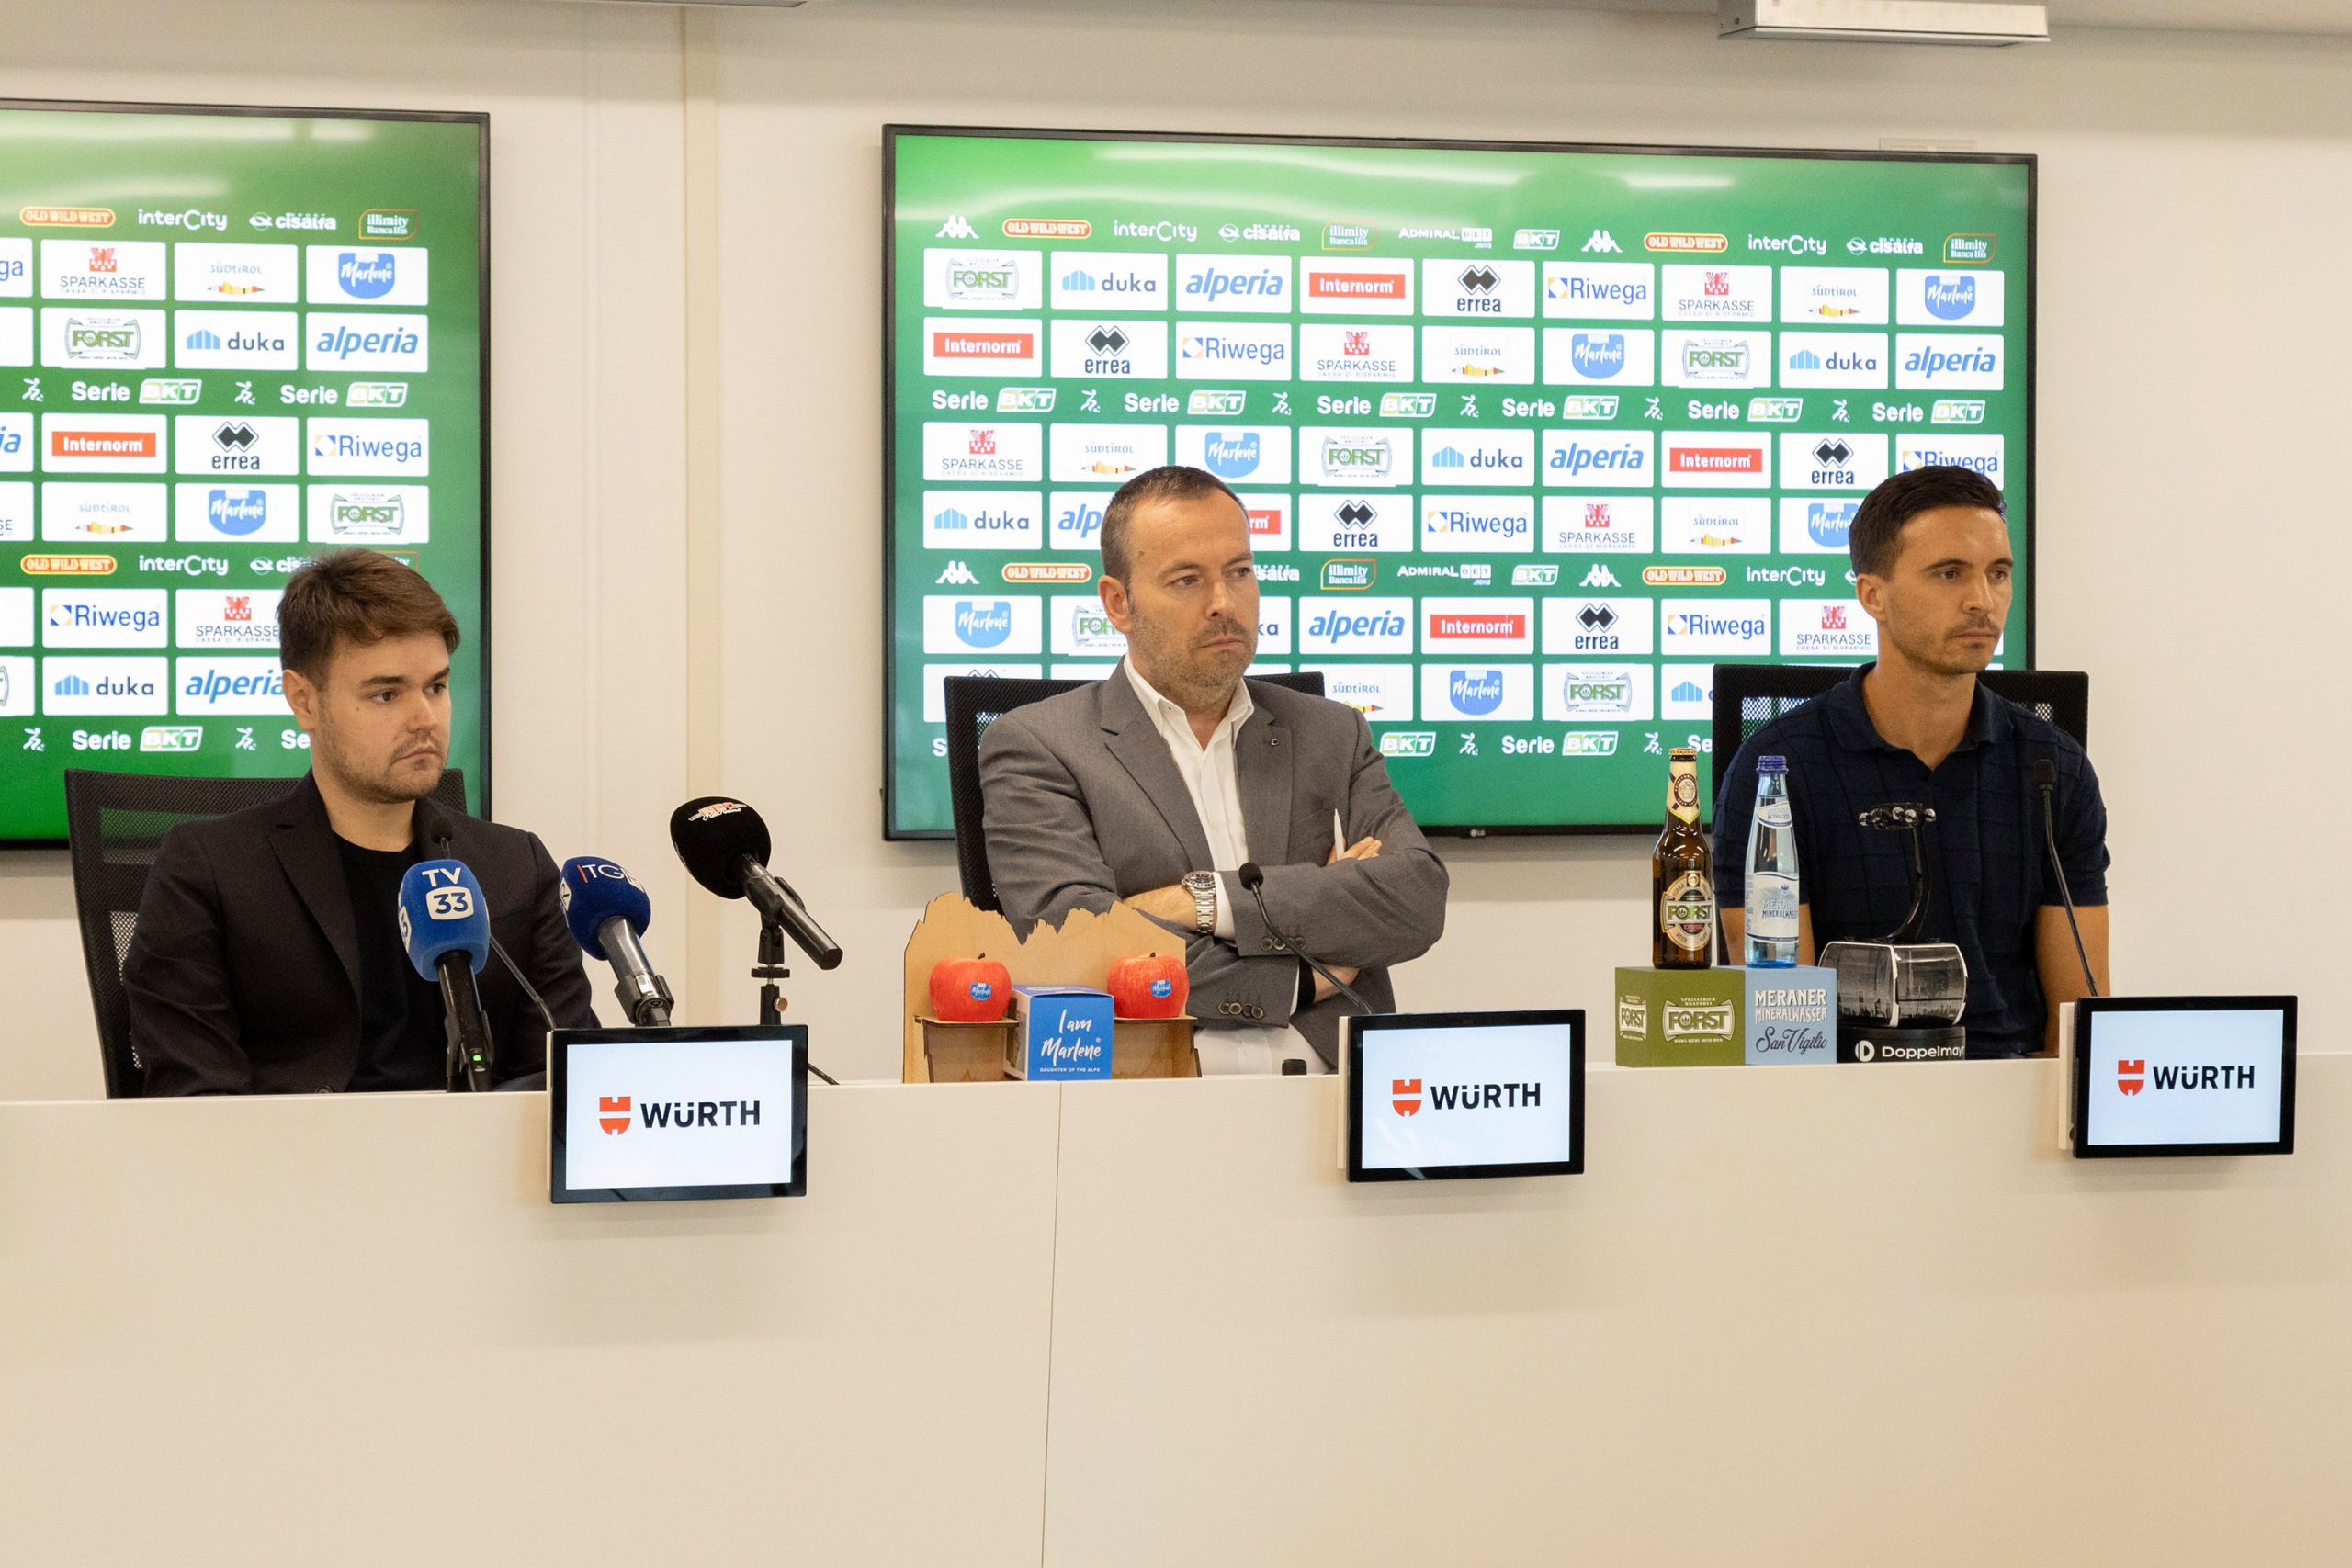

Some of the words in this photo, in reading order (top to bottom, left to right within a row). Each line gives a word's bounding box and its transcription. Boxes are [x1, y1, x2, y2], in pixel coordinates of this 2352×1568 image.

[26, 210, 49, 221] OLD
[49, 211, 78, 222] WILD
[78, 211, 110, 223] WEST
[138, 209, 228, 231] interCity
[368, 213, 409, 227] illimity
[1008, 221, 1029, 235] OLD
[1029, 222, 1057, 235] WILD
[1057, 223, 1088, 236] WEST
[1114, 220, 1198, 242] interCity
[1329, 225, 1369, 238] illimity
[1516, 231, 1556, 246] BKT
[1648, 236, 1668, 248] OLD
[1668, 236, 1695, 249] WILD
[1695, 237, 1724, 249] WEST
[1748, 234, 1826, 255] interCity
[1951, 238, 1988, 252] illimity
[61, 276, 145, 289] SPARKASSE
[341, 261, 393, 287] Marlene
[953, 271, 1012, 289] FORST
[1102, 273, 1156, 292] duka
[1186, 268, 1283, 301] alperia
[1319, 278, 1394, 294] Internorm
[1570, 278, 1647, 304] Riwega
[1457, 296, 1501, 312] errea
[1679, 299, 1755, 312] SPARKASSE
[1928, 285, 1973, 308] Marlene
[73, 328, 134, 347] FORST
[228, 331, 285, 352] duka
[316, 326, 418, 360] alperia
[944, 338, 1023, 354] Internorm
[1205, 337, 1285, 365] Riwega
[1574, 343, 1623, 367] Marlene
[1689, 350, 1744, 368] FORST
[1084, 358, 1131, 375] errea
[1317, 359, 1396, 372] SPARKASSE
[1826, 352, 1877, 371] duka
[1904, 347, 1996, 378] alperia
[71, 381, 130, 401] Serie
[143, 383, 198, 400] BKT
[279, 384, 338, 405] Serie
[350, 387, 404, 403] BKT
[933, 390, 989, 411] Serie
[1000, 391, 1053, 409] BKT
[1125, 392, 1180, 412] Serie
[1190, 393, 1242, 411] BKT
[1317, 396, 1371, 415] Serie
[1383, 397, 1432, 413] BKT
[1502, 399, 1555, 418] Serie
[1566, 400, 1616, 416] BKT
[1688, 400, 1740, 421] Serie
[1751, 401, 1800, 418] BKT
[1872, 402, 1924, 423] Serie
[1935, 403, 1983, 421] BKT
[62, 436, 143, 453] Internorm
[339, 435, 422, 463] Riwega
[1208, 440, 1259, 463] Marlene
[211, 453, 260, 470] errea
[942, 458, 1023, 470] SPARKASSE
[1329, 448, 1385, 467] FORST
[1470, 448, 1523, 468] duka
[1550, 443, 1644, 476] alperia
[1679, 453, 1752, 468] Internorm
[1811, 469, 1855, 485] errea
[210, 498, 265, 524] Marlene
[337, 506, 399, 524] FORST
[974, 510, 1030, 530] duka
[1450, 512, 1528, 537] Riwega
[1333, 533, 1378, 547] errea
[1559, 532, 1636, 544] SPARKASSE
[27, 558, 49, 570] OLD
[49, 558, 79, 570] WILD
[79, 558, 111, 571] WEST
[139, 555, 228, 575] interCity
[1007, 567, 1029, 579] OLD
[1029, 567, 1057, 580] WILD
[1057, 567, 1089, 580] WEST
[1329, 564, 1368, 578] illimity
[1515, 567, 1555, 582] BKT
[1647, 570, 1668, 581] OLD
[1668, 570, 1694, 581] WILD
[1693, 570, 1723, 581] WEST
[1747, 566, 1826, 587] interCity
[75, 604, 160, 632] Riwega
[957, 611, 1008, 636] Marlene
[1308, 610, 1405, 644] alperia
[1441, 619, 1513, 634] Internorm
[1690, 614, 1765, 640] Riwega
[196, 626, 280, 637] SPARKASSE
[1795, 634, 1871, 646] SPARKASSE
[1575, 635, 1619, 649] errea
[96, 676, 154, 696] duka
[185, 669, 284, 704] alperia
[1453, 682, 1501, 706] Marlene
[1569, 683, 1626, 701] FORST
[73, 730, 131, 750] Serie
[144, 731, 198, 748] BKT
[1383, 735, 1433, 753] BKT
[1502, 736, 1555, 754] Serie
[1566, 735, 1616, 753] BKT
[422, 867, 462, 887] TV
[433, 892, 469, 915] 33
[1755, 988, 1827, 1007] MERANER
[1058, 1009, 1068, 1033] I
[1067, 1020, 1091, 1033] am
[1621, 1008, 1645, 1029] FORST
[1668, 1010, 1730, 1031] FORST
[1755, 1007, 1827, 1024] MINERALWASSER
[1756, 1026, 1785, 1053] San
[1783, 1027, 1827, 1055] Vigilio
[1041, 1038, 1102, 1066] Marlene
[2153, 1065, 2256, 1090] WÜRTH
[1430, 1082, 1541, 1111] WÜRTH
[640, 1100, 761, 1129] WÜRTH
